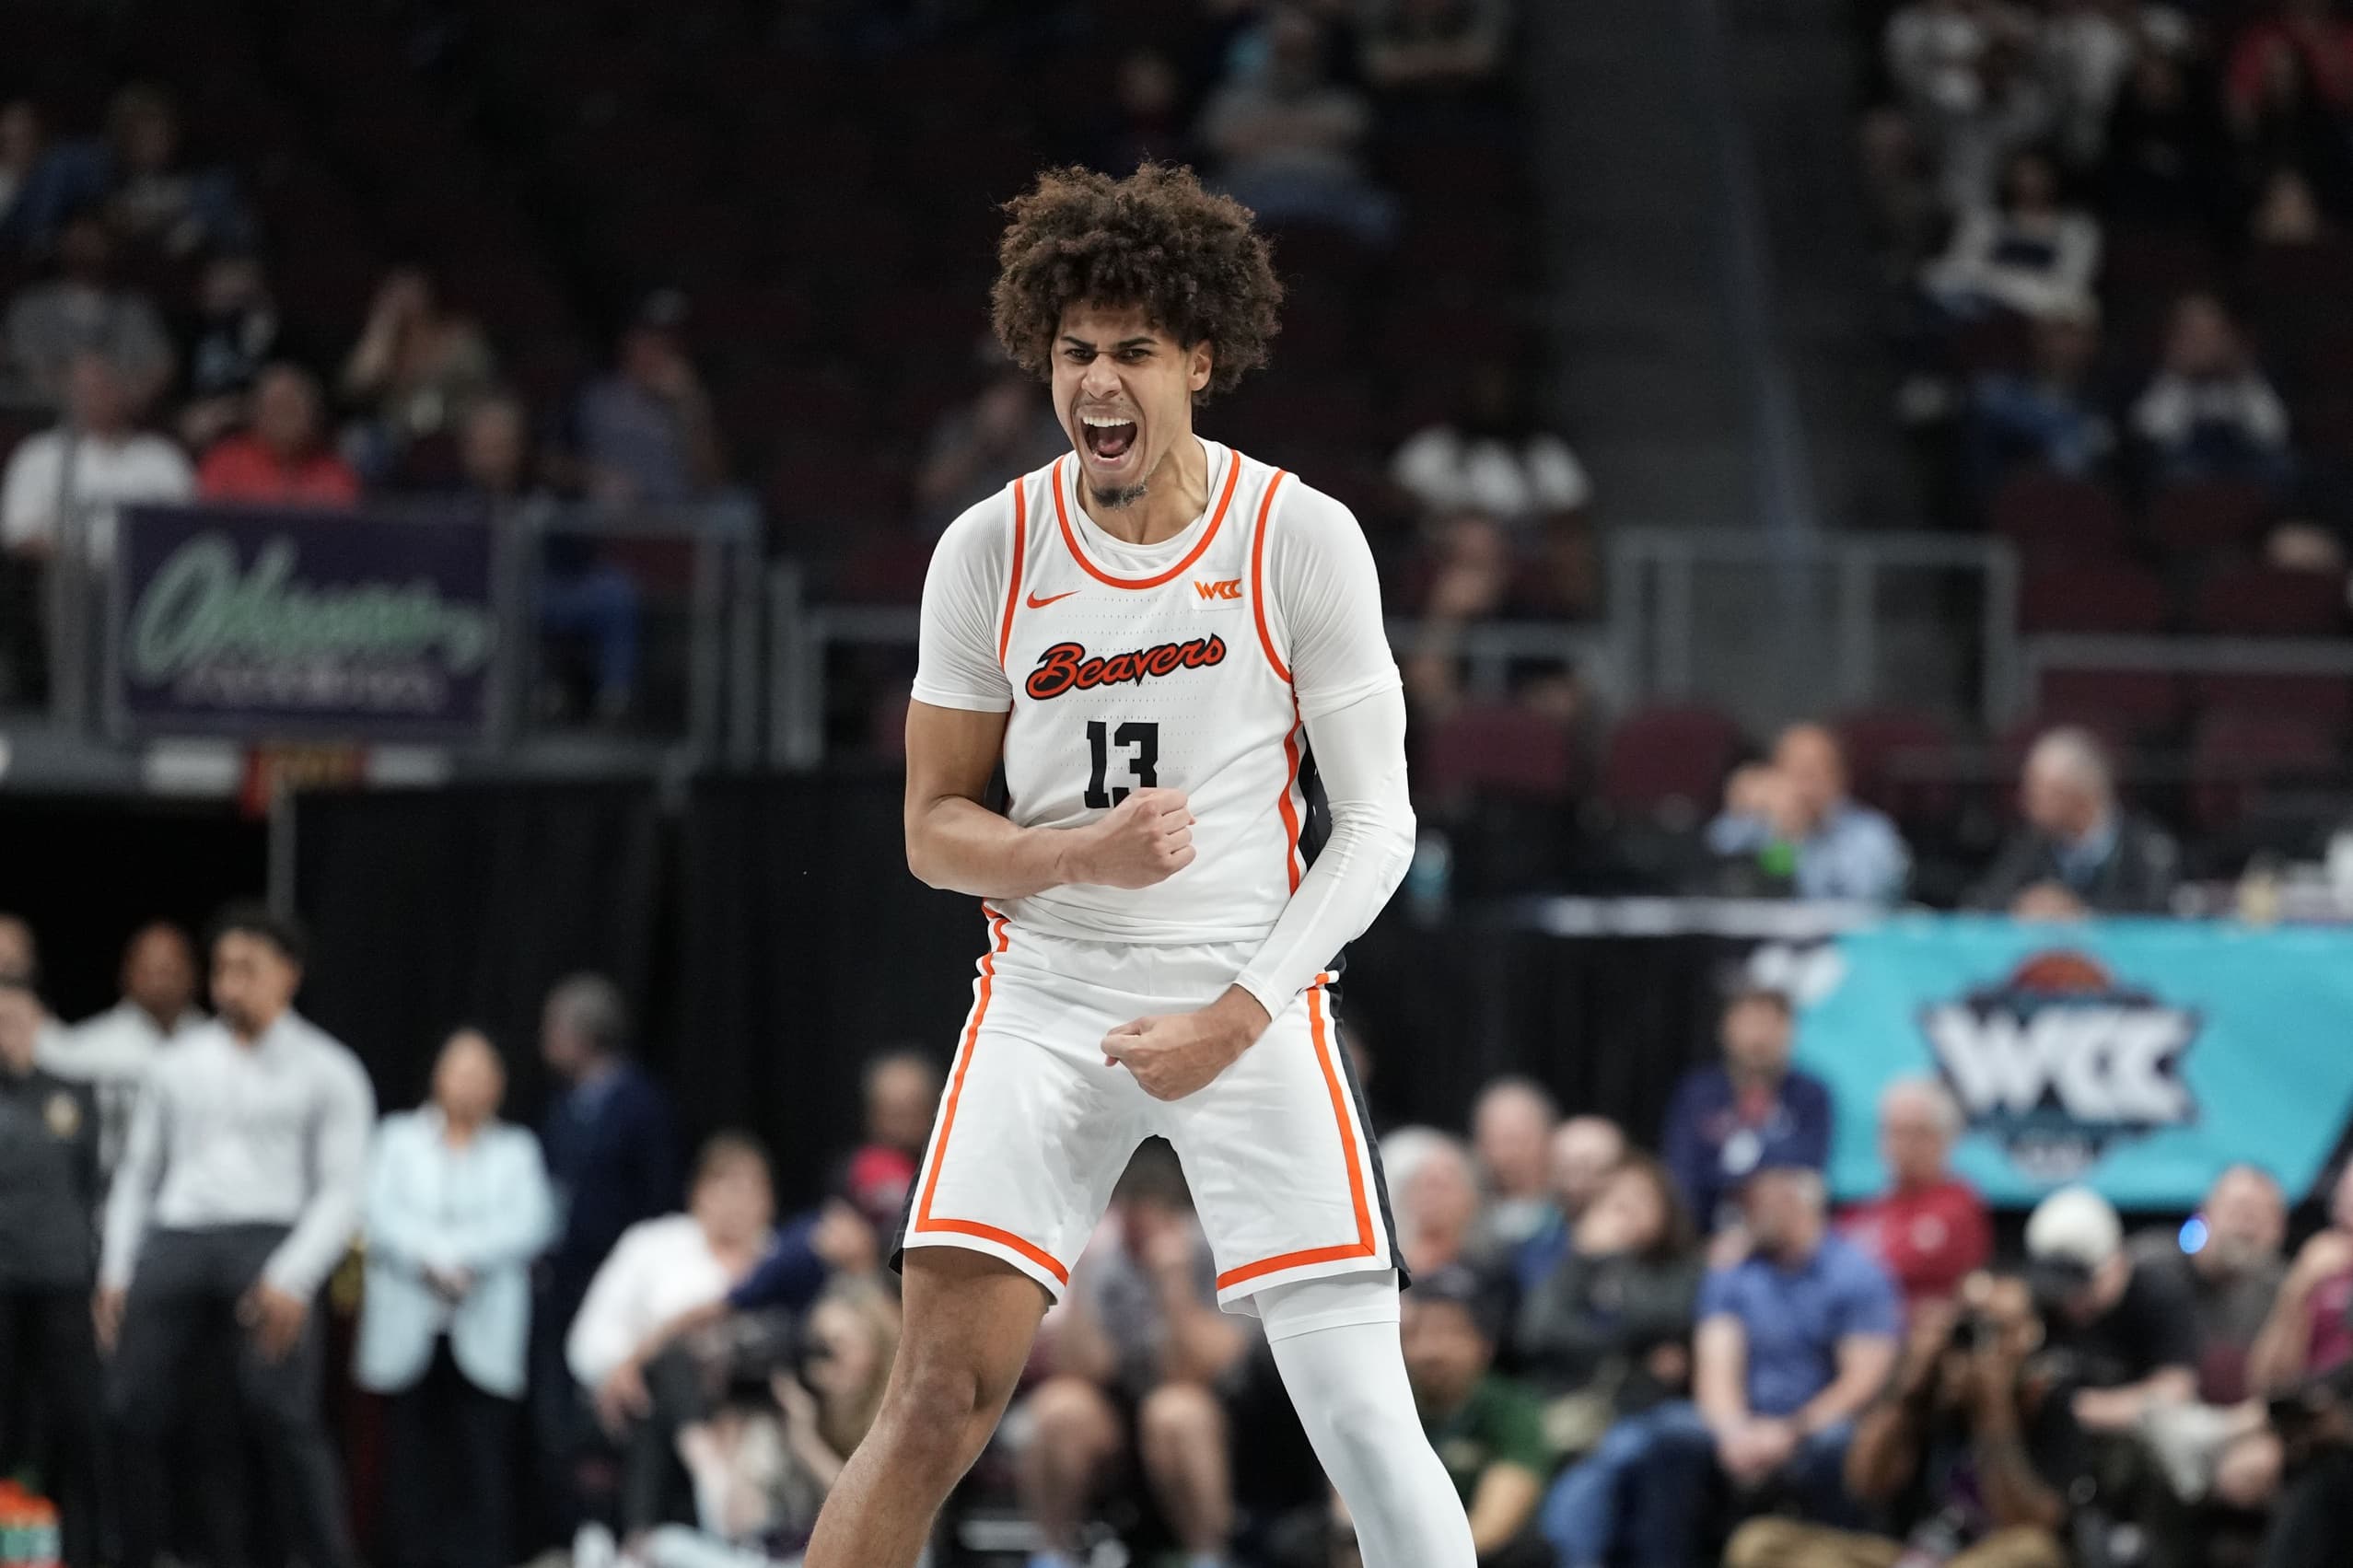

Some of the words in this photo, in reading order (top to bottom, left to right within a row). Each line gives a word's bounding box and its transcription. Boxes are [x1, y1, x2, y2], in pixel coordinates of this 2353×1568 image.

[1194, 578, 1243, 600] WCC
[1025, 633, 1227, 700] Beavers
[1084, 720, 1159, 809] 13
[1925, 1005, 2197, 1125] WCC
